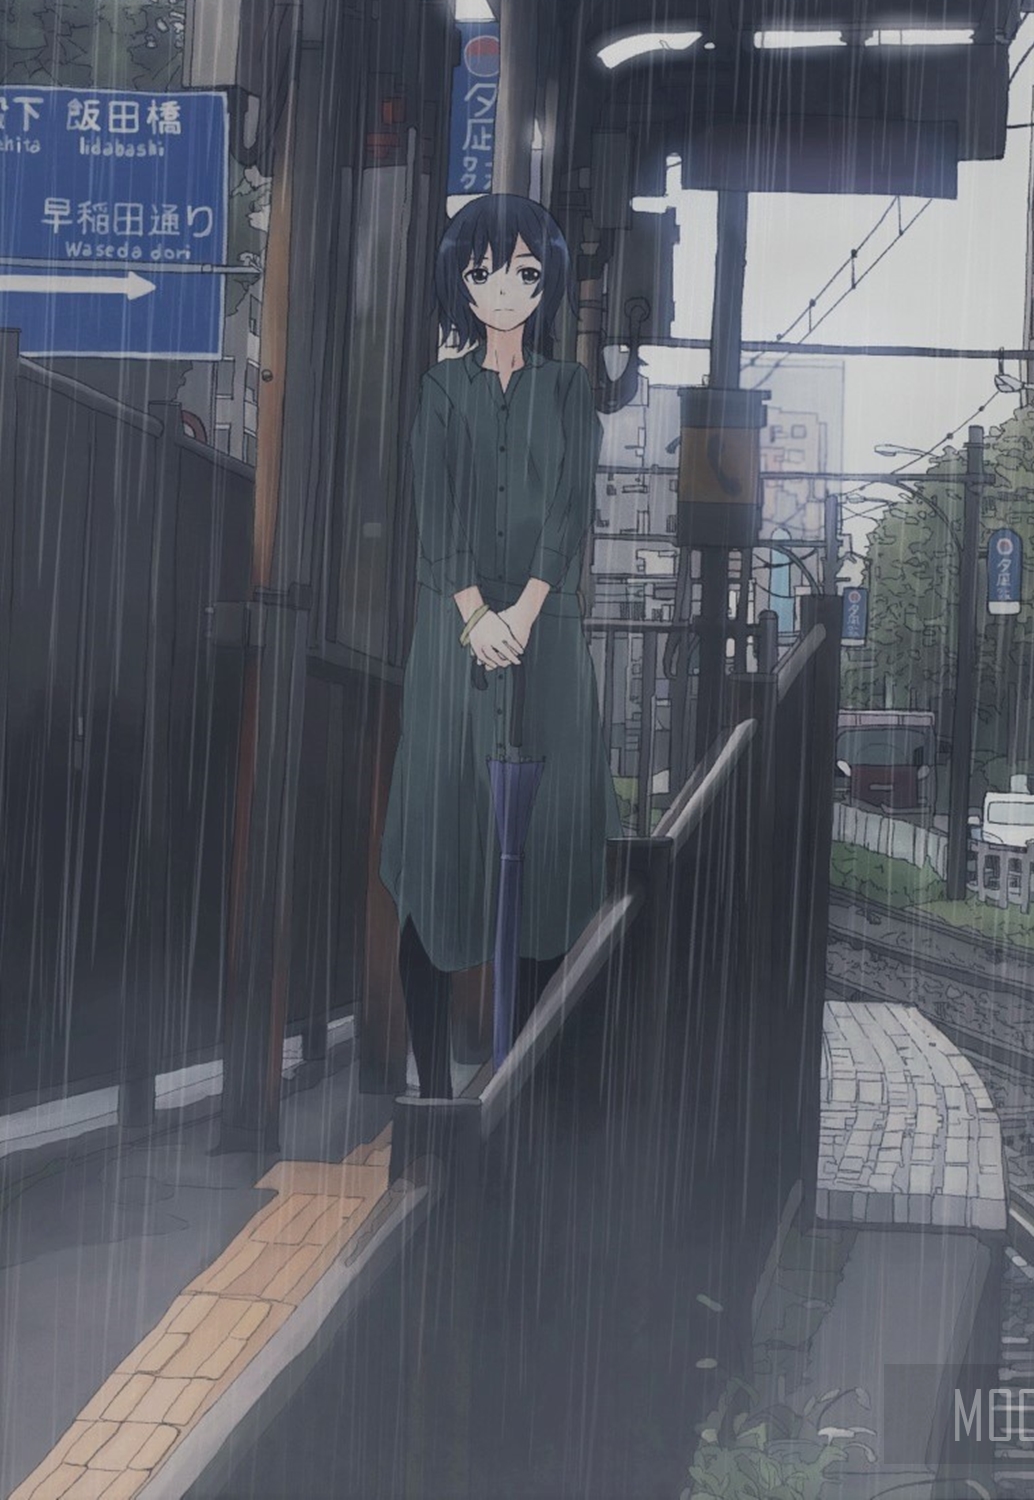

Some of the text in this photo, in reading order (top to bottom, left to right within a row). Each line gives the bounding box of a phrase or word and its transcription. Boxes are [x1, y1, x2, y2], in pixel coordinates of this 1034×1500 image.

[66, 98, 182, 135] 飯田橋
[80, 135, 165, 157] Iidabashi
[41, 197, 214, 238] 早稲田通り
[65, 240, 191, 260] Waseda dori
